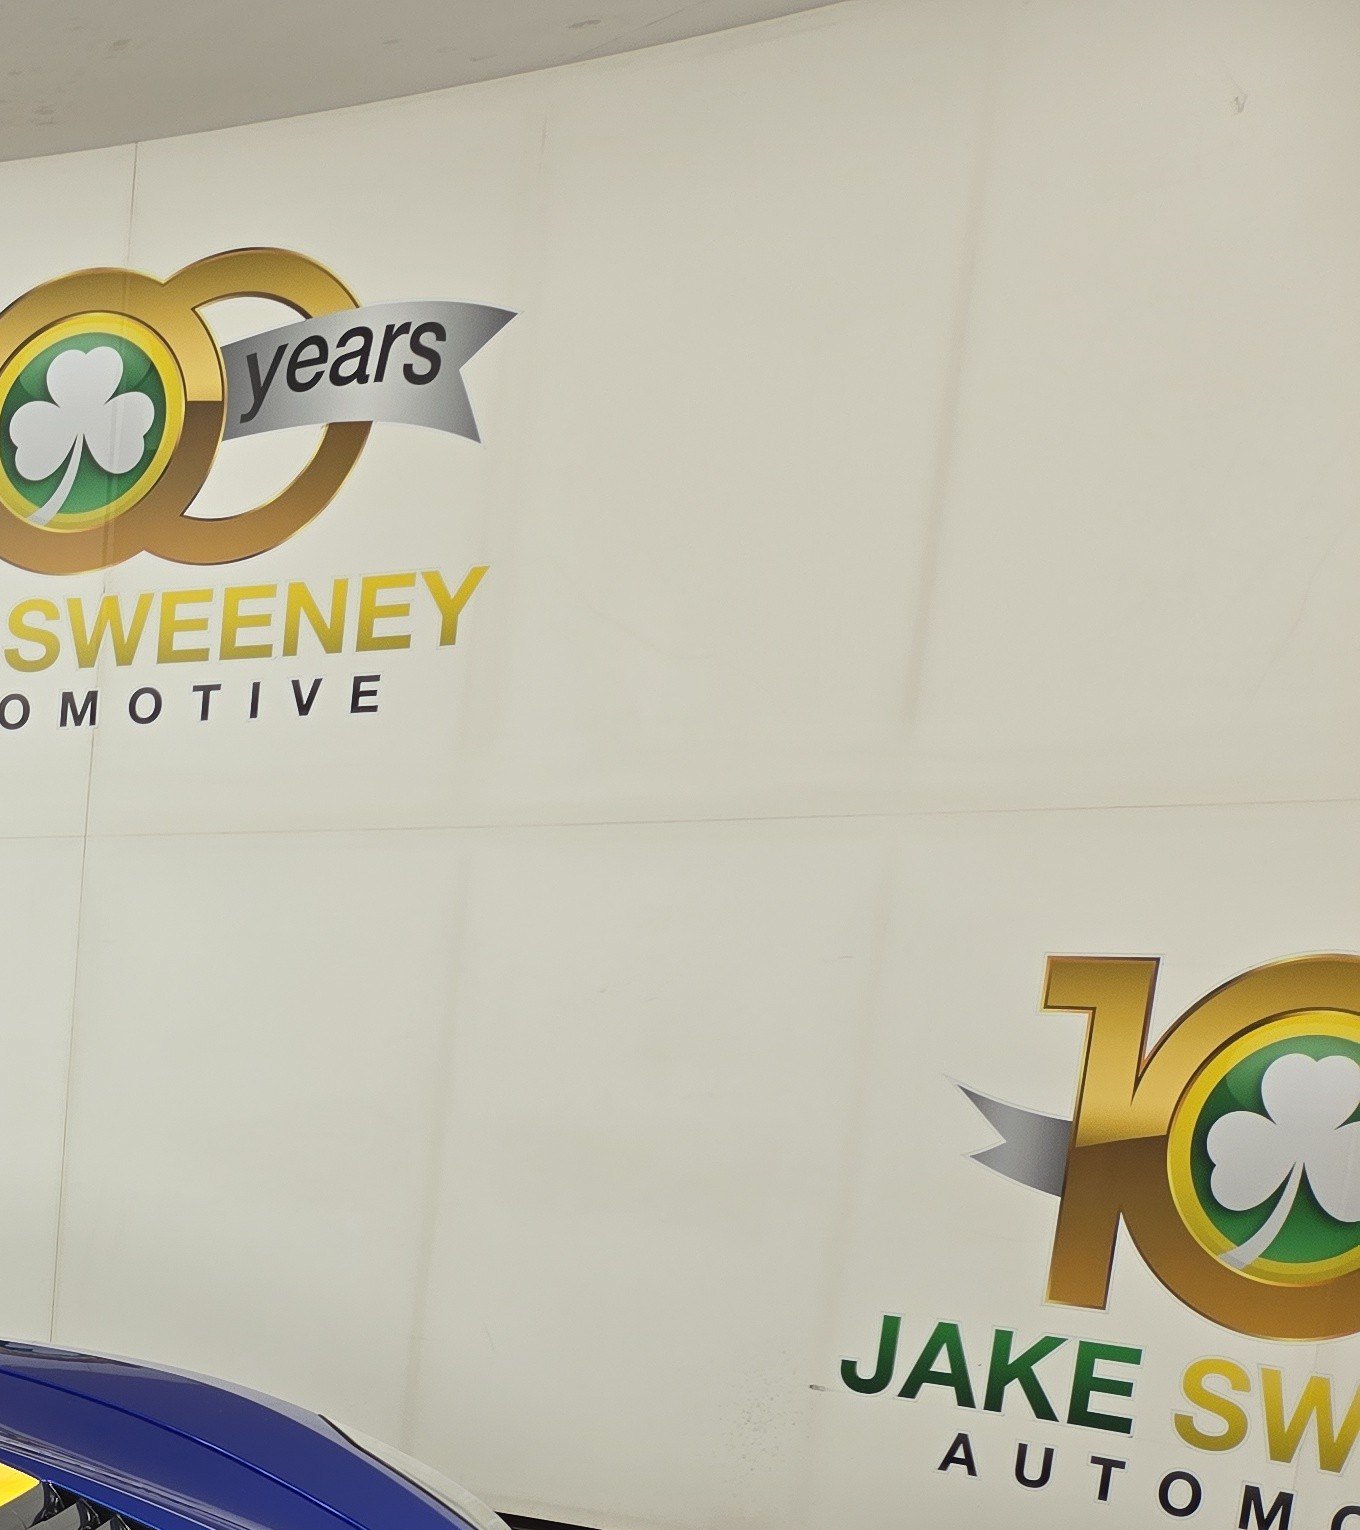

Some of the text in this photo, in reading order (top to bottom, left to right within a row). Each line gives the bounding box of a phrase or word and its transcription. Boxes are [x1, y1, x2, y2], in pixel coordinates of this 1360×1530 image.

[240, 321, 447, 423] years
[3, 565, 491, 674] SWEENEY
[840, 1314, 1142, 1435] JAKE
